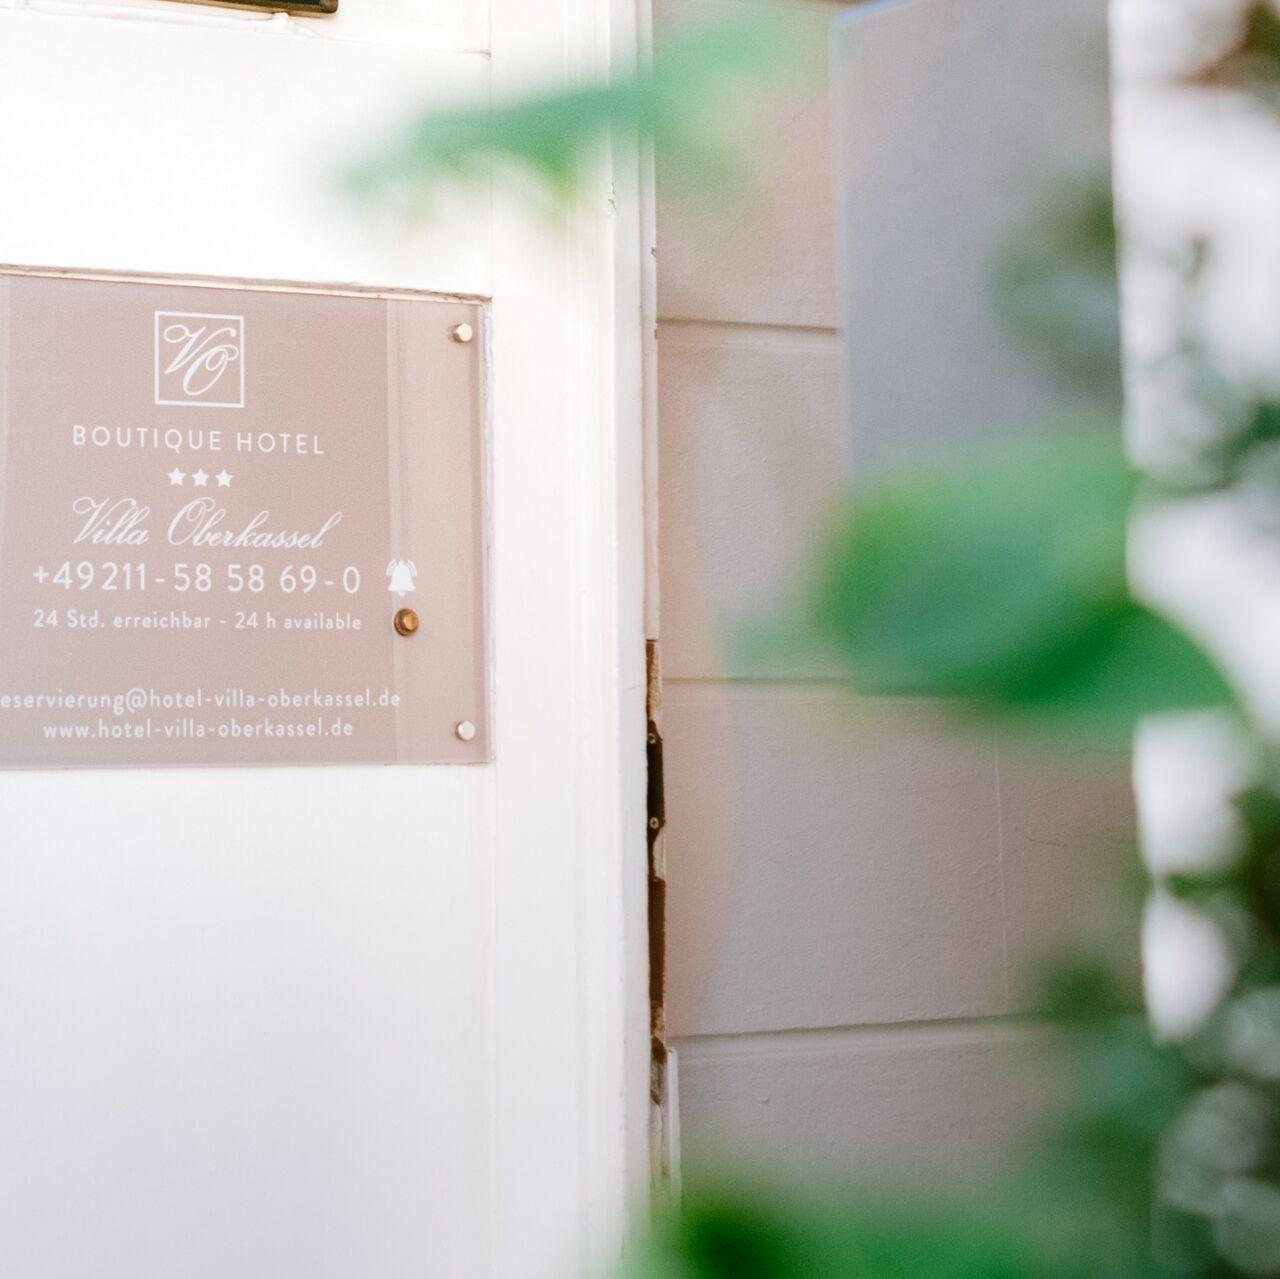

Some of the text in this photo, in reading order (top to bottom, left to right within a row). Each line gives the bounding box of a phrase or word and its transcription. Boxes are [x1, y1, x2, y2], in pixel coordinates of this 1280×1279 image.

[72, 424, 325, 455] BOUTIQUE HOTEL
[72, 496, 343, 549] Villa Oberkassel
[227, 563, 265, 593] 58
[33, 608, 59, 628] 24
[66, 608, 105, 629] Std.
[112, 610, 212, 629] erreichbar
[234, 610, 259, 630] 24
[266, 611, 277, 629] h
[283, 612, 362, 631] available
[43, 717, 354, 739] www.hotel-villa-oberkassel.de
